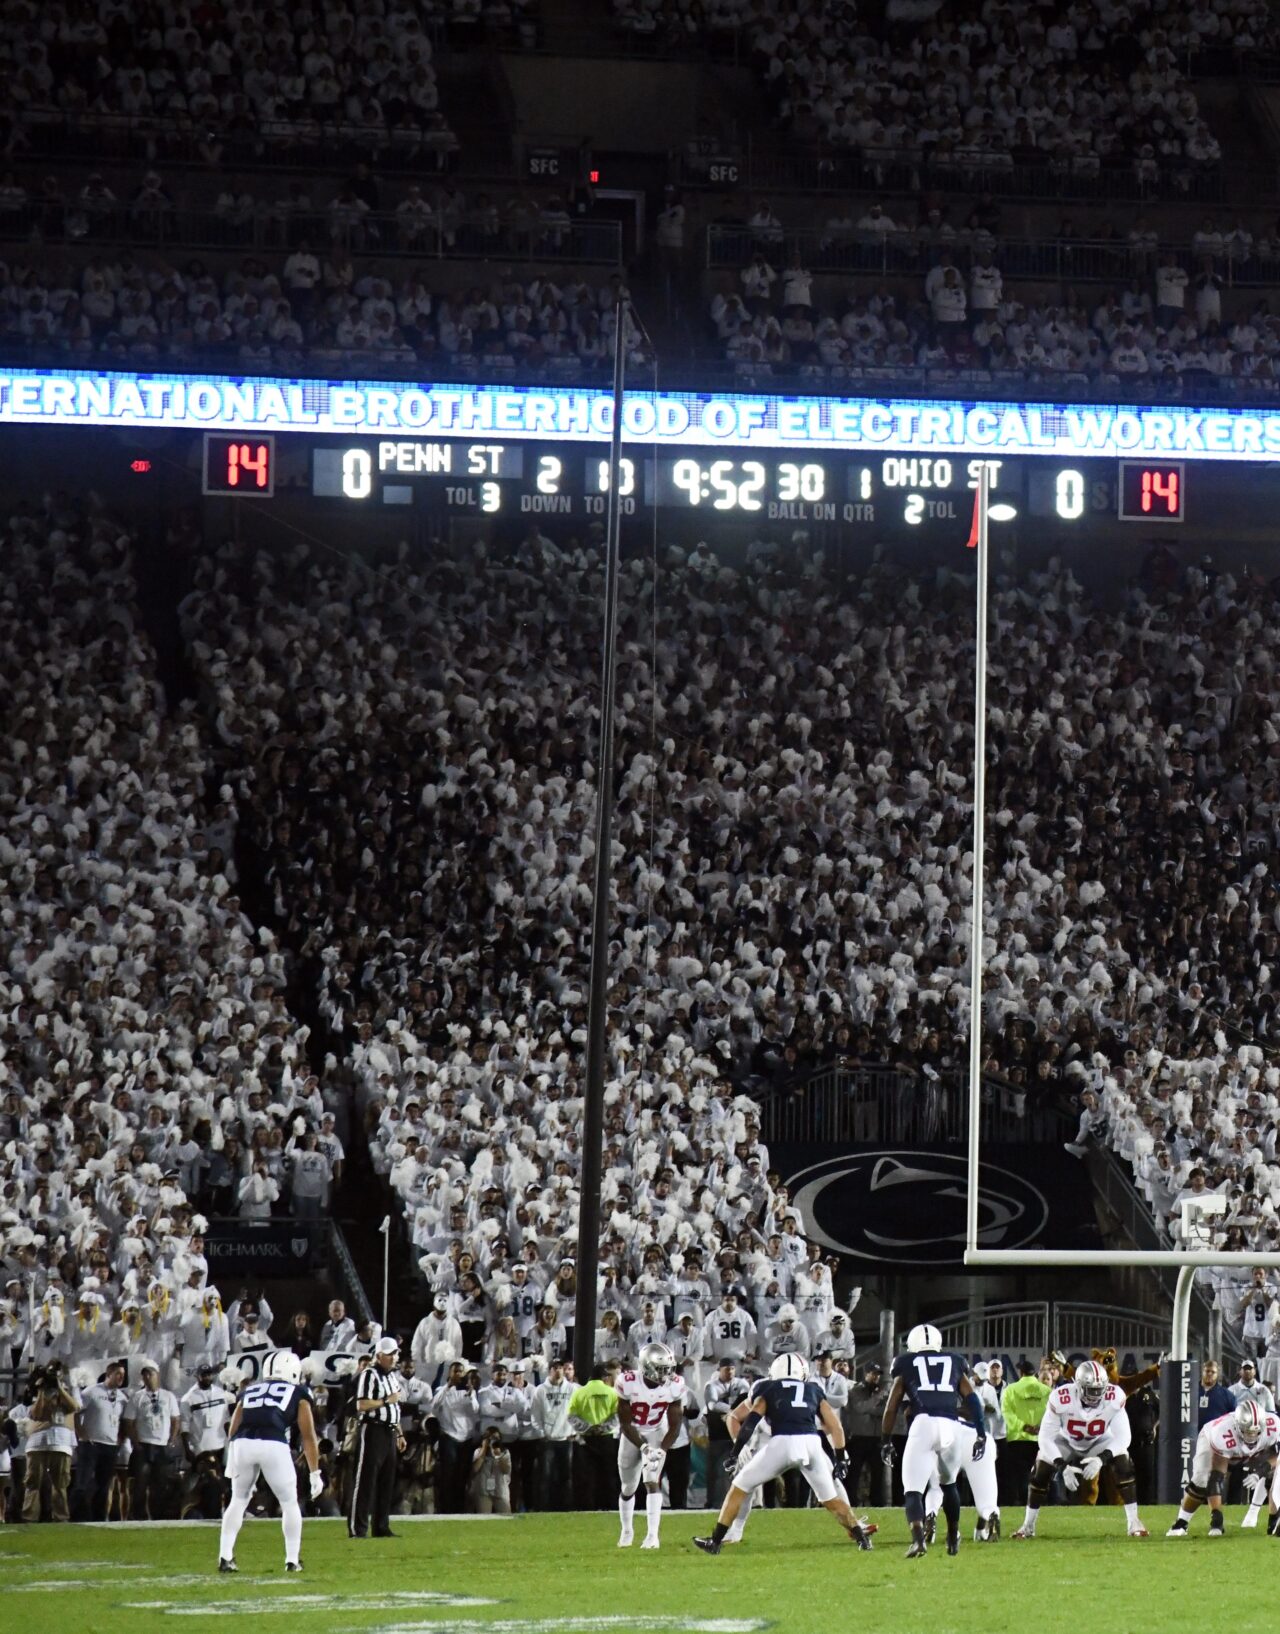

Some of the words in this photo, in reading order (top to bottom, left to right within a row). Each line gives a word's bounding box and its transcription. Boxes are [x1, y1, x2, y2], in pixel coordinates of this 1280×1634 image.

[530, 158, 559, 175] SFC
[710, 165, 739, 182] SFC
[332, 386, 690, 436] BROTHERHOOD
[703, 400, 766, 438] OF
[778, 402, 1056, 448] ELECTRICAL
[227, 443, 267, 488] 14
[342, 448, 372, 498] 0
[378, 441, 452, 473] PENN
[468, 444, 504, 475] ST
[882, 456, 952, 489] OHIO
[967, 459, 1003, 489] ST
[536, 456, 562, 494] 2
[673, 459, 766, 512] 9:52
[778, 463, 825, 501] 30
[860, 468, 872, 500] 1
[445, 486, 476, 505] TOL
[481, 481, 501, 513] 3
[520, 495, 572, 513] DOWN
[584, 496, 605, 514] TO
[1056, 469, 1084, 519] 0
[1141, 471, 1178, 513] 14
[768, 500, 807, 520] BALL
[814, 501, 836, 521] ON
[843, 503, 875, 522] QTR
[904, 494, 925, 525] 2
[927, 500, 957, 519] TOL
[1254, 1303, 1266, 1322] 9
[718, 1321, 742, 1340] 36
[912, 1355, 953, 1392] 17
[242, 1382, 296, 1412] 29
[781, 1380, 808, 1408] 7
[1058, 1387, 1071, 1405] 59
[1181, 1362, 1192, 1423] PENN
[1066, 1418, 1106, 1442] 59
[1222, 1429, 1237, 1449] 78
